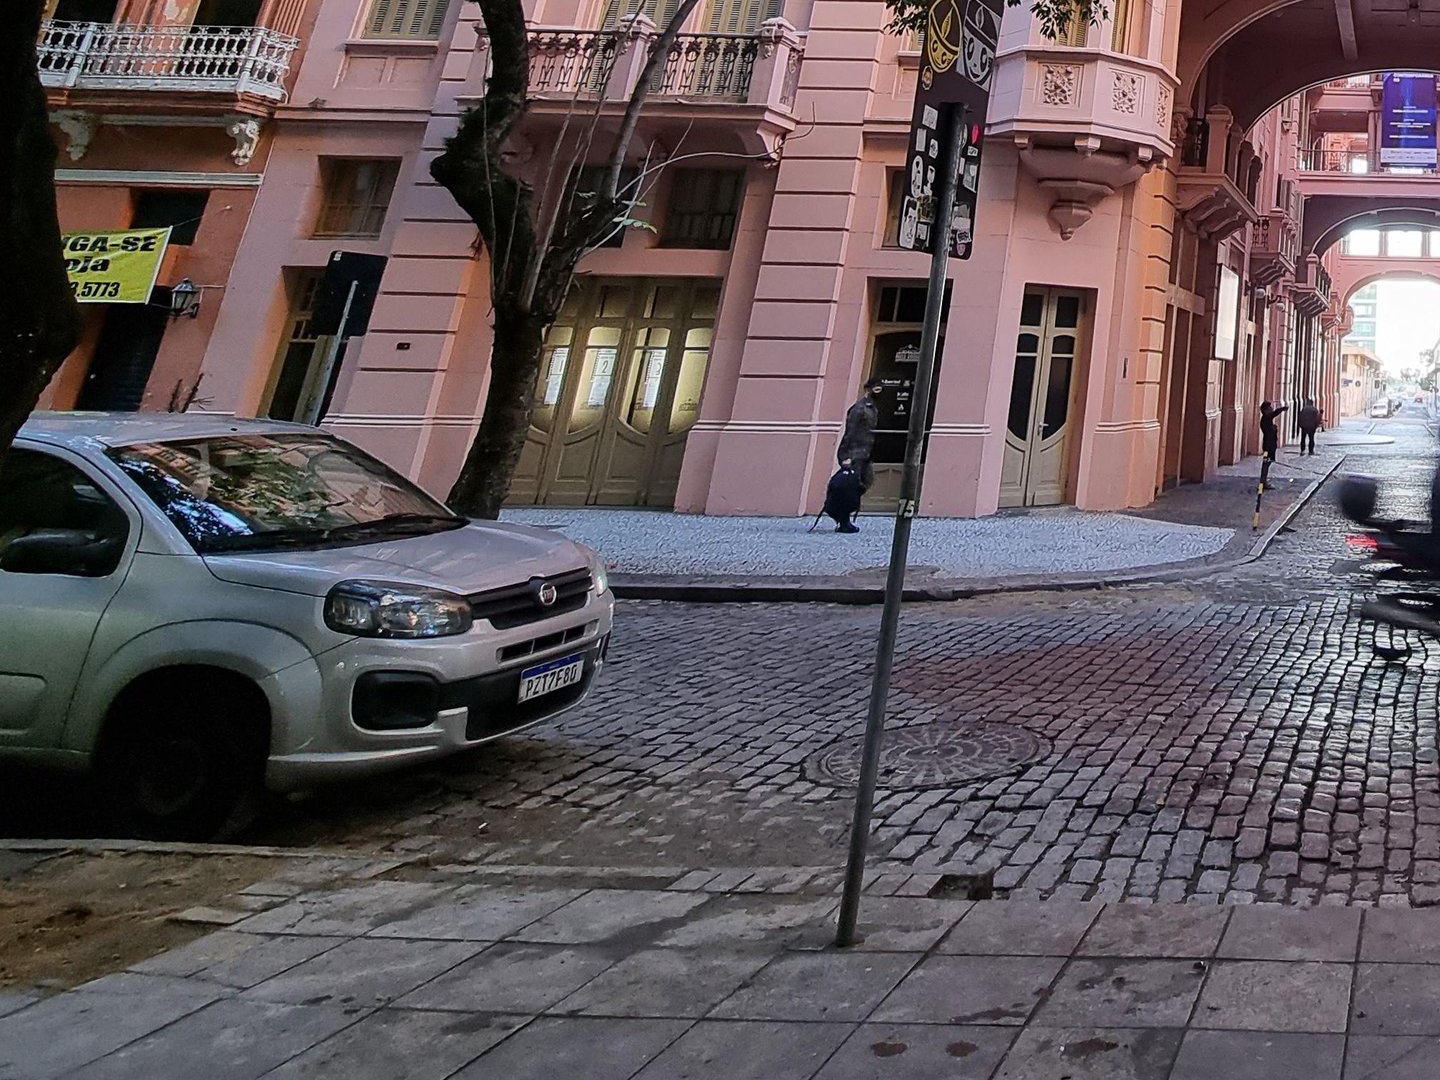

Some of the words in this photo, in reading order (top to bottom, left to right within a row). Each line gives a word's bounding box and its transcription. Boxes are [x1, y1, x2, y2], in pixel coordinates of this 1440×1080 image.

[62, 236, 158, 252] GA-SE
[64, 257, 111, 273] oja
[601, 360, 609, 373] 2
[899, 499, 915, 518] 75
